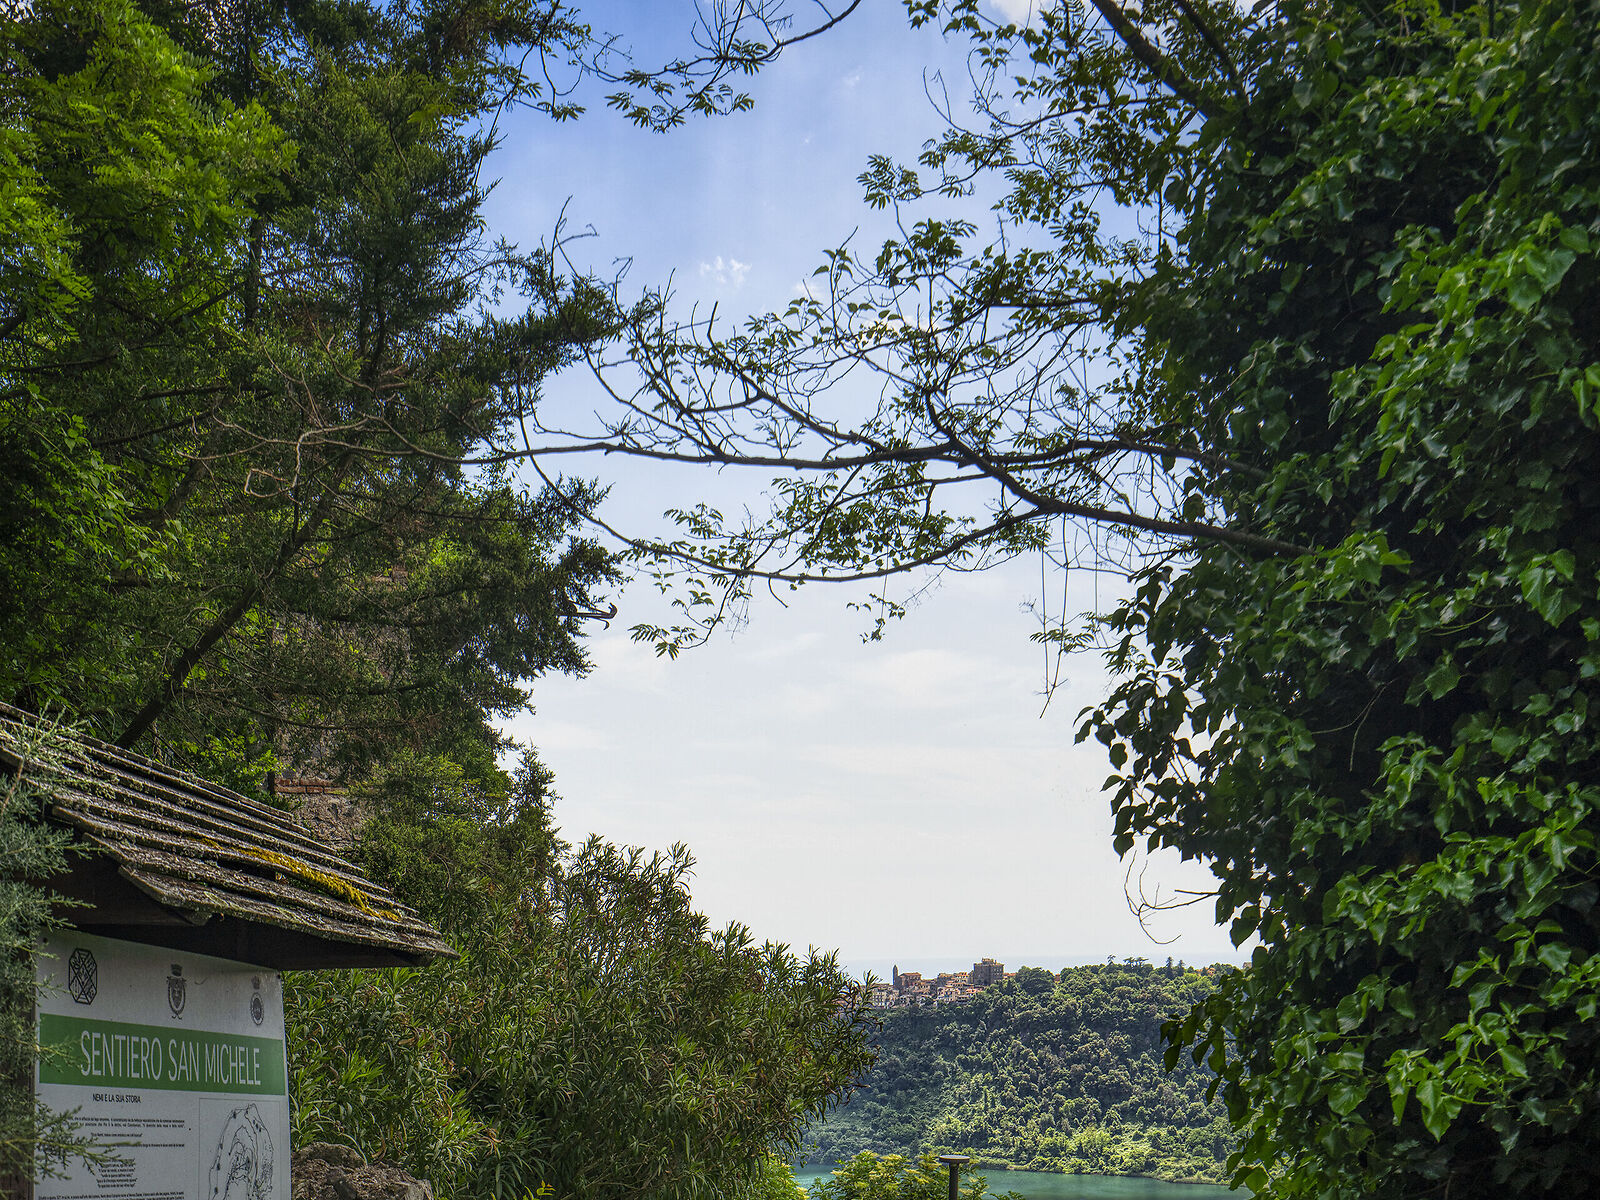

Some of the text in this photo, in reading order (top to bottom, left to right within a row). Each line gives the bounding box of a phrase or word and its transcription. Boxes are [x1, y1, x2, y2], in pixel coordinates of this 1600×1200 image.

[80, 1031, 262, 1086] SENTIERO SAN MICHELE
[108, 1094, 115, 1102] LA
[115, 1094, 125, 1103] SUA
